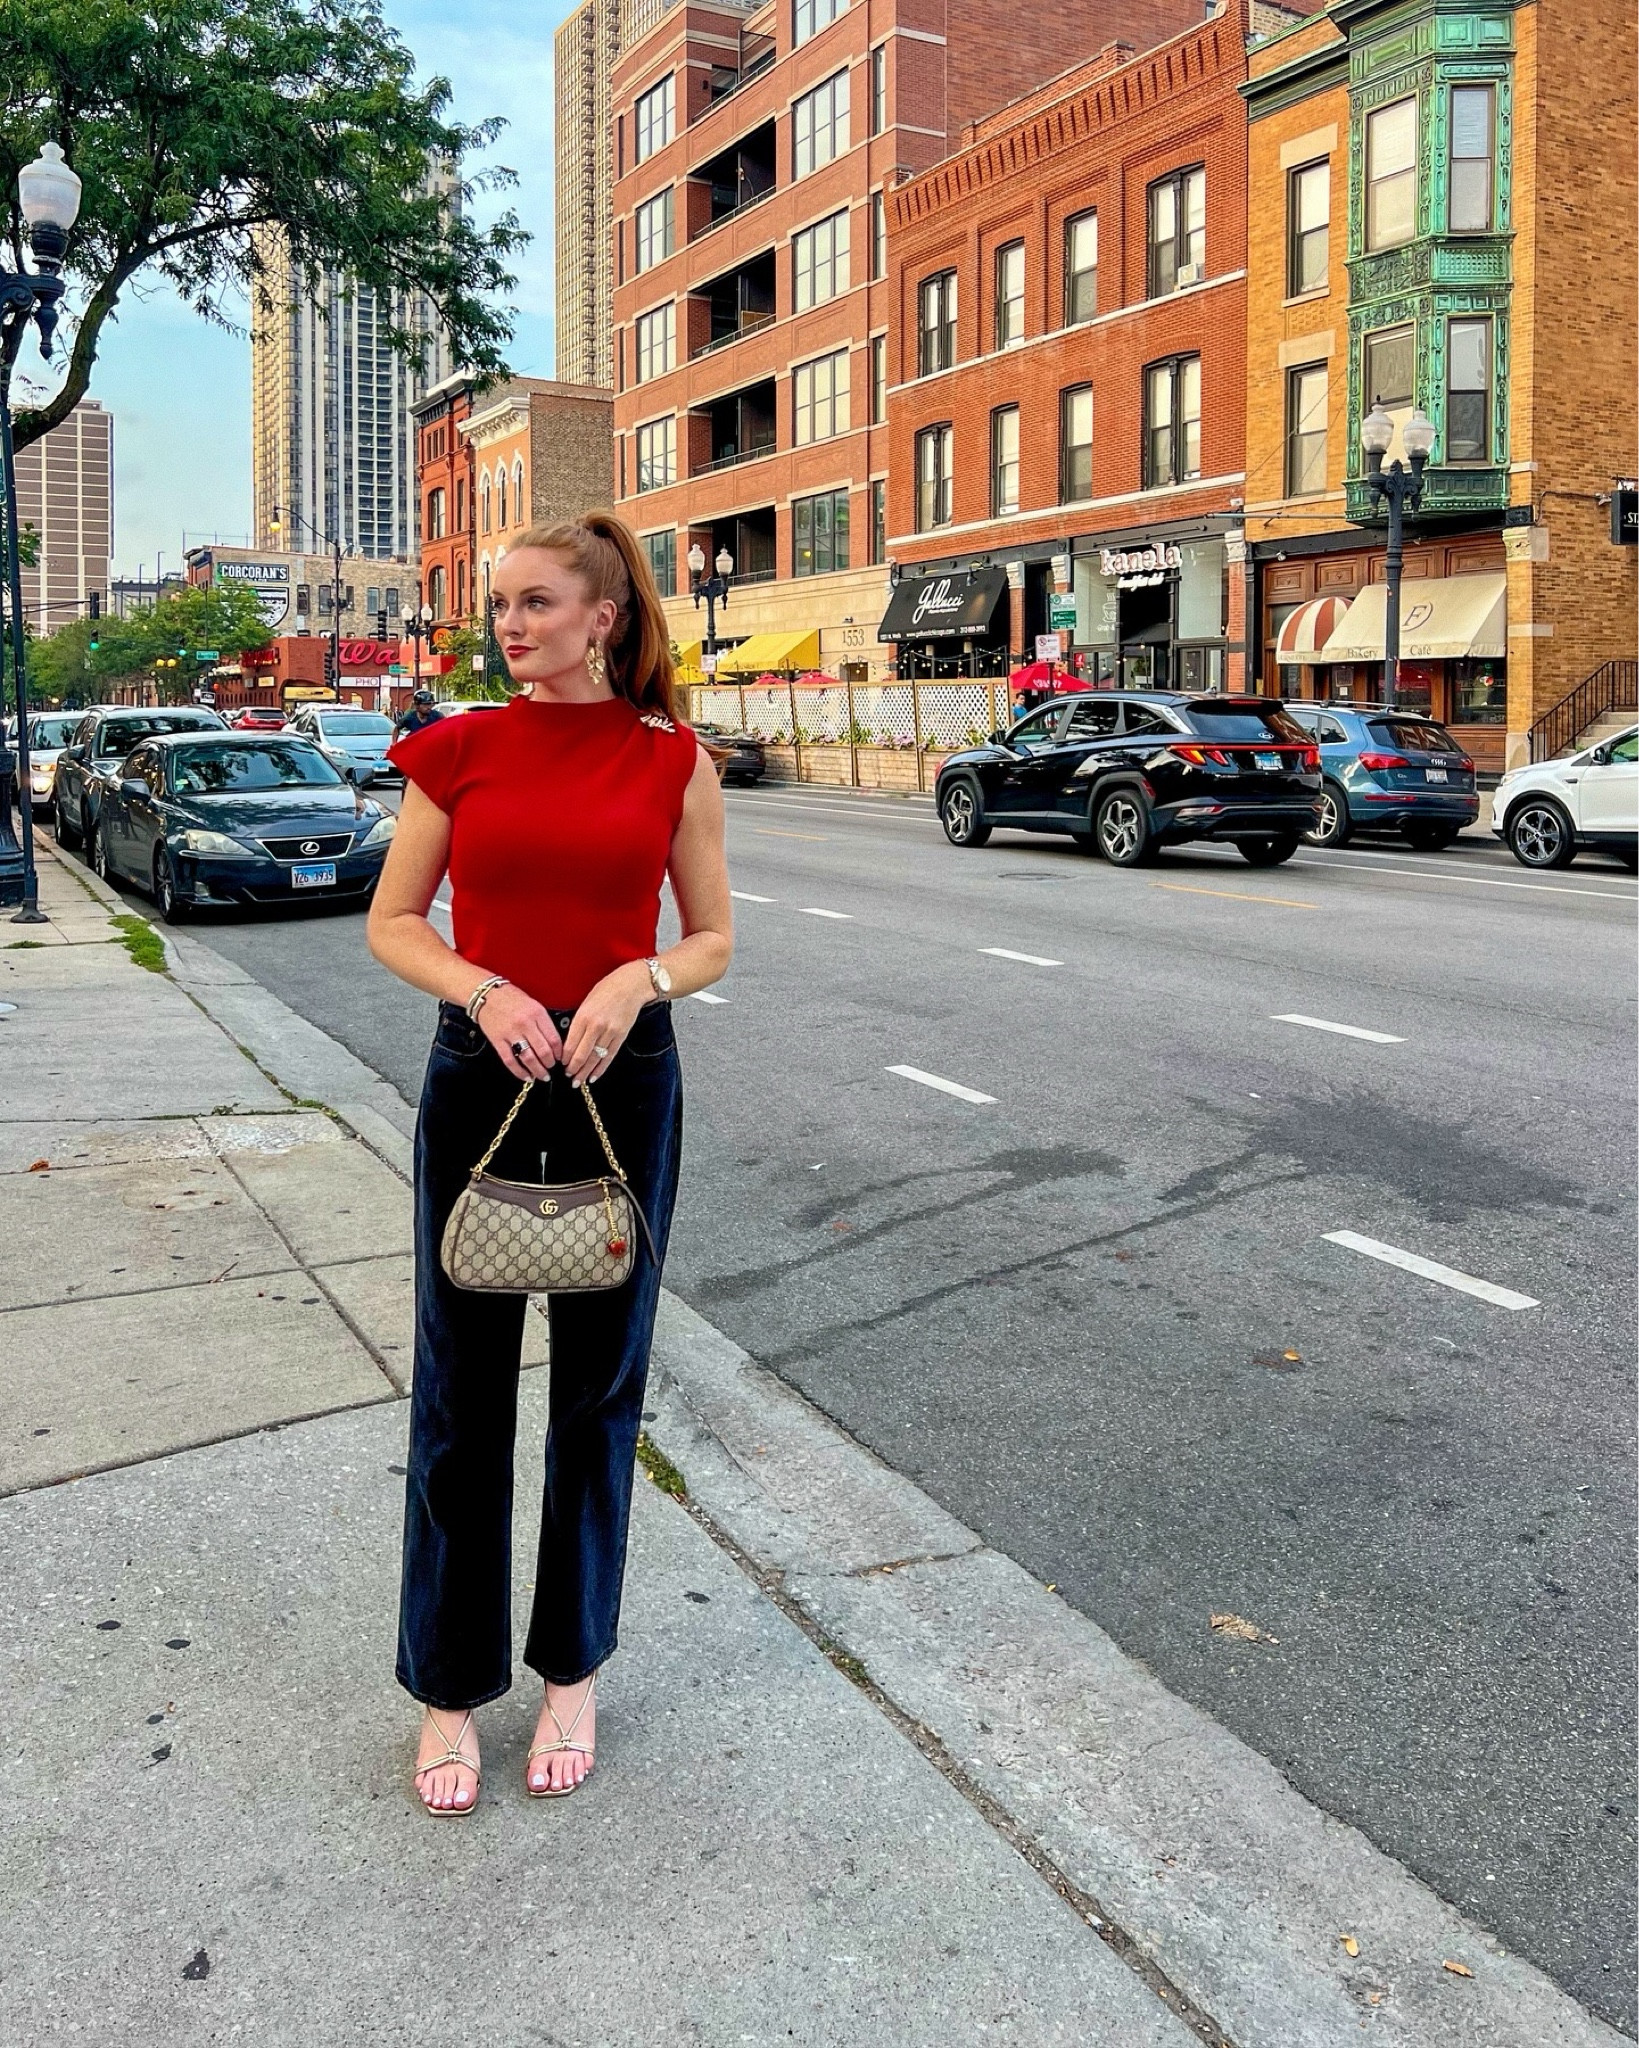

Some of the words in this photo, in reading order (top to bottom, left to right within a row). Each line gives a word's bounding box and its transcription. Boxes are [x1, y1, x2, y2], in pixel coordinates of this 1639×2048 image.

[1099, 542, 1183, 576] kanela
[221, 565, 287, 580] CORCORAN'S
[842, 628, 865, 647] 1553
[1347, 648, 1378, 661] Bakery
